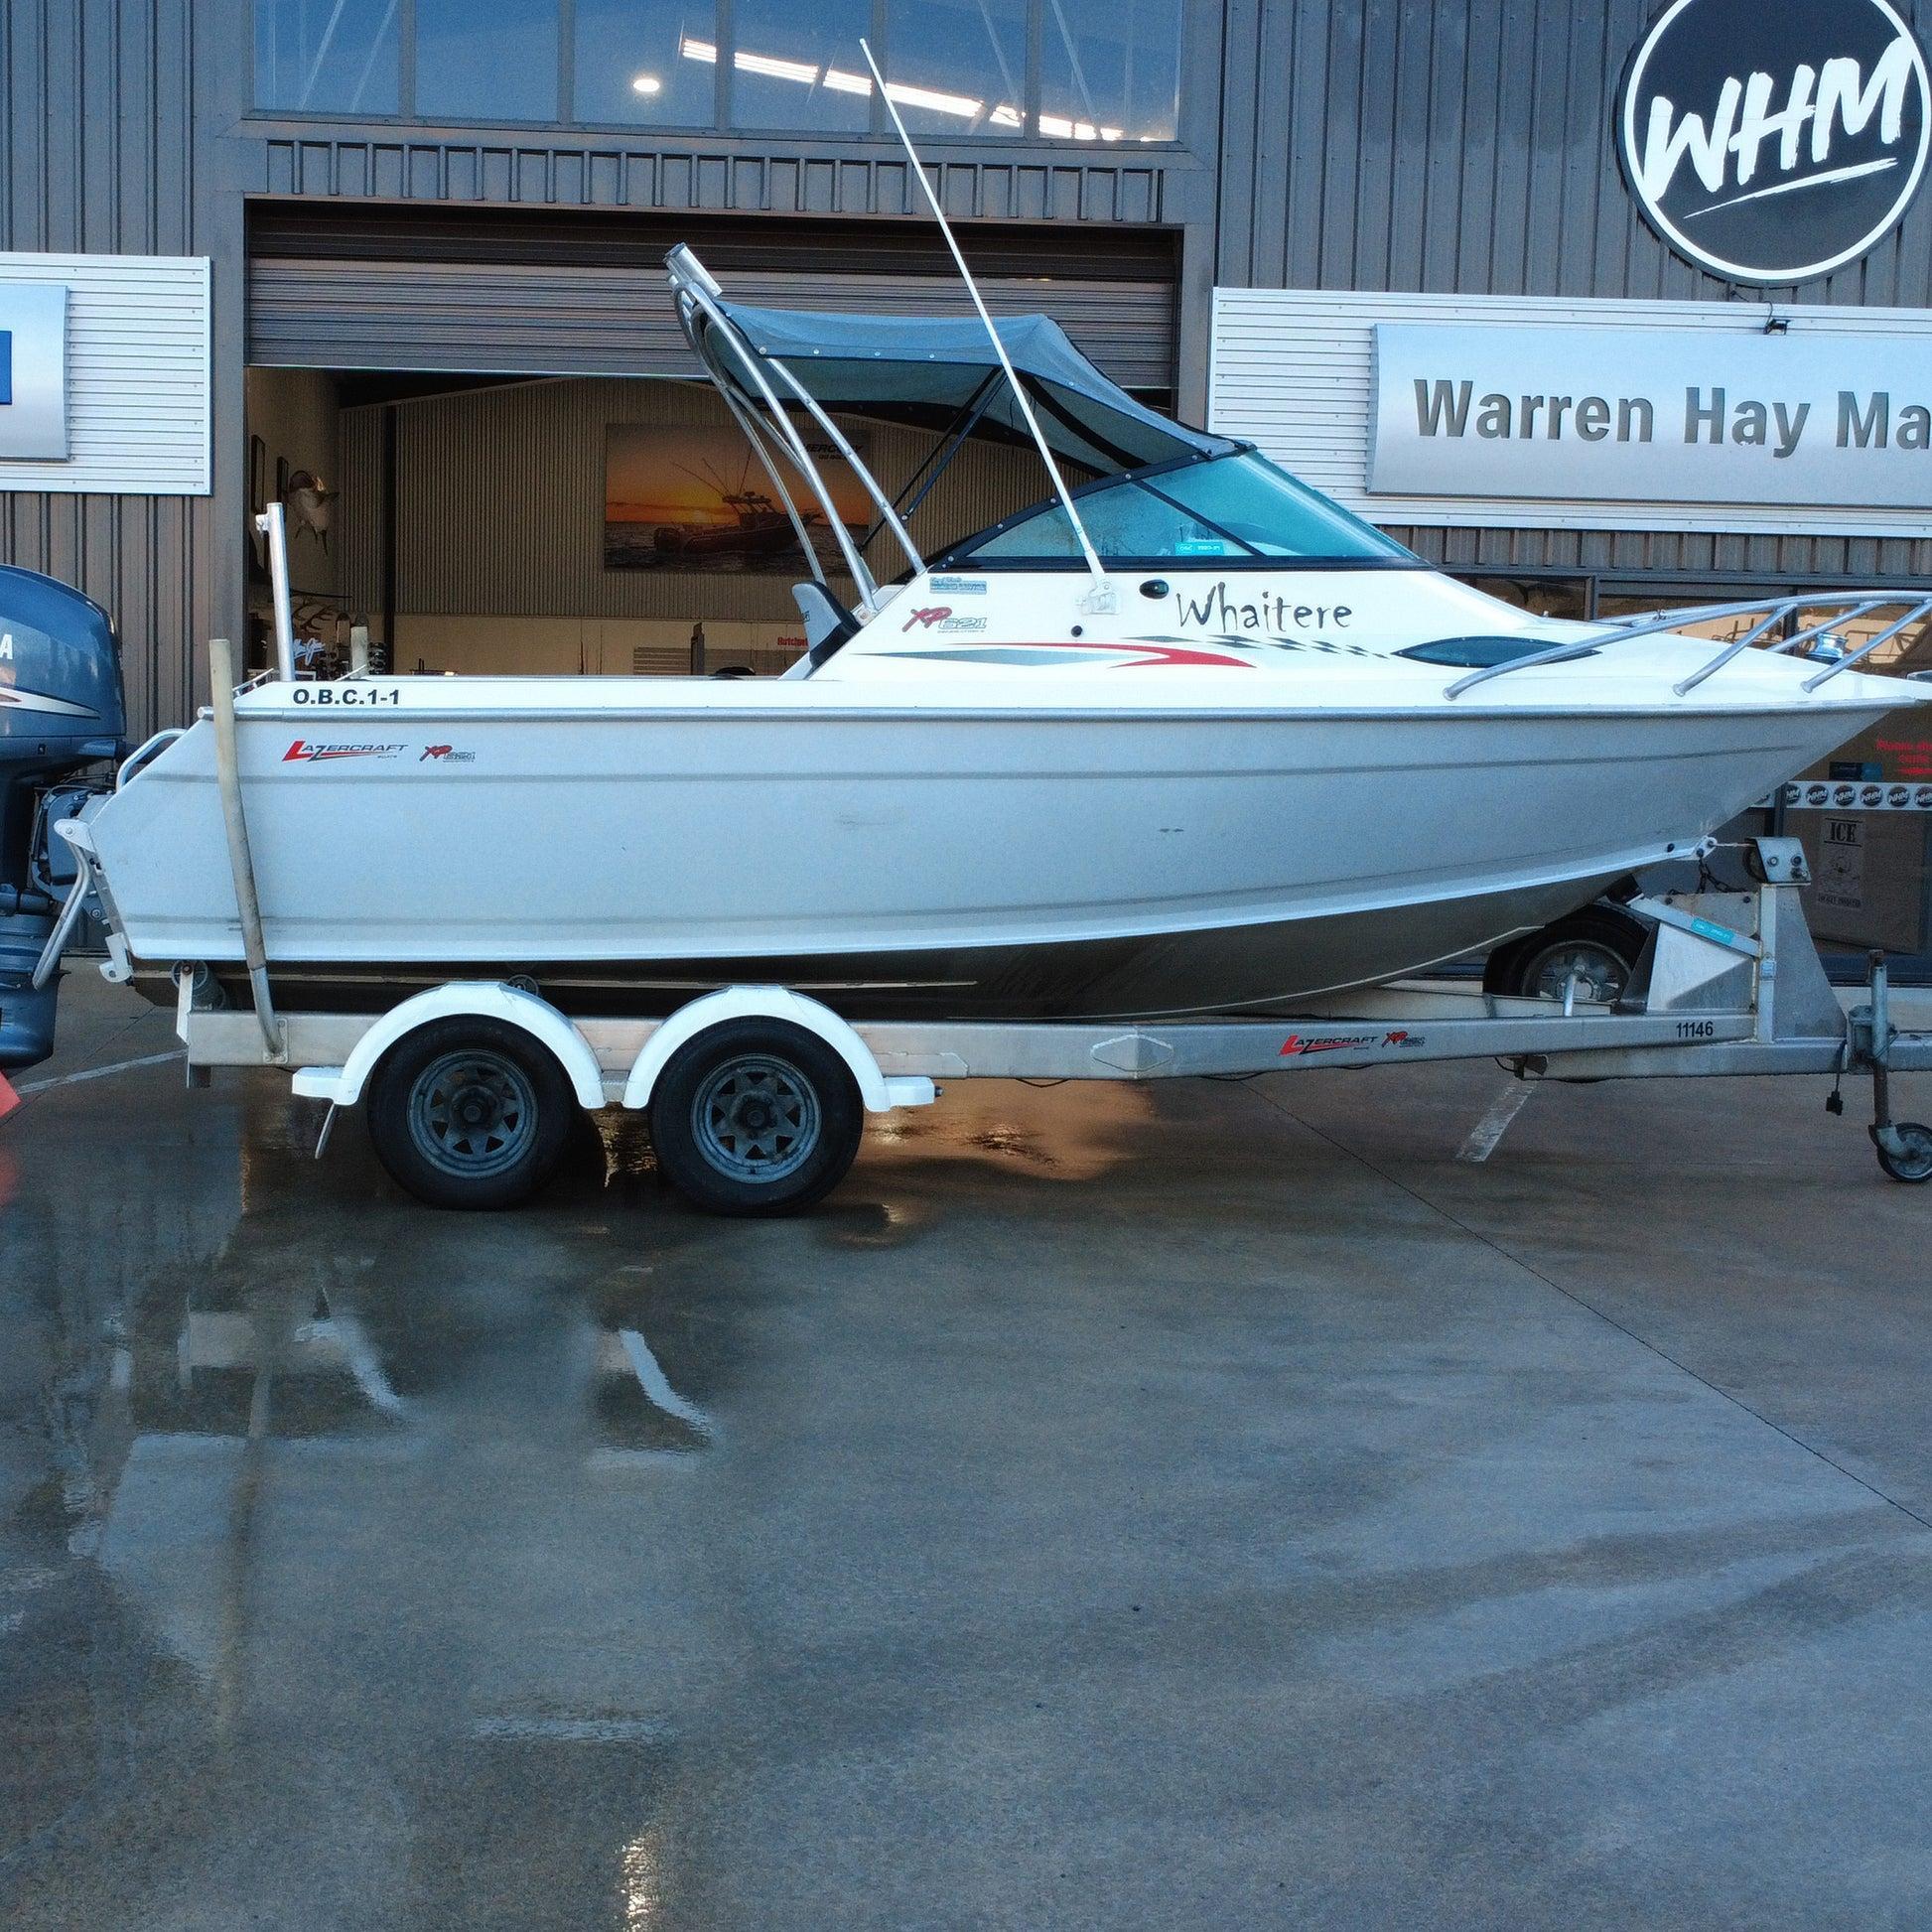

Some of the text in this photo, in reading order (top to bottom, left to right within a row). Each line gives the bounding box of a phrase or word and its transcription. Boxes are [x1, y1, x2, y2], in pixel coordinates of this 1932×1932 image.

[1644, 37, 1916, 203] WHM
[1414, 379, 1931, 459] Warren Hay Ma
[1175, 582, 1352, 633] Whaitere
[293, 689, 399, 705] O.B.C.1-1
[282, 741, 409, 762] LAZERCRAFT
[1830, 822, 1857, 843] ICE
[1676, 1021, 1714, 1037] 11146
[1279, 1035, 1378, 1055] LAZERCRAFT
